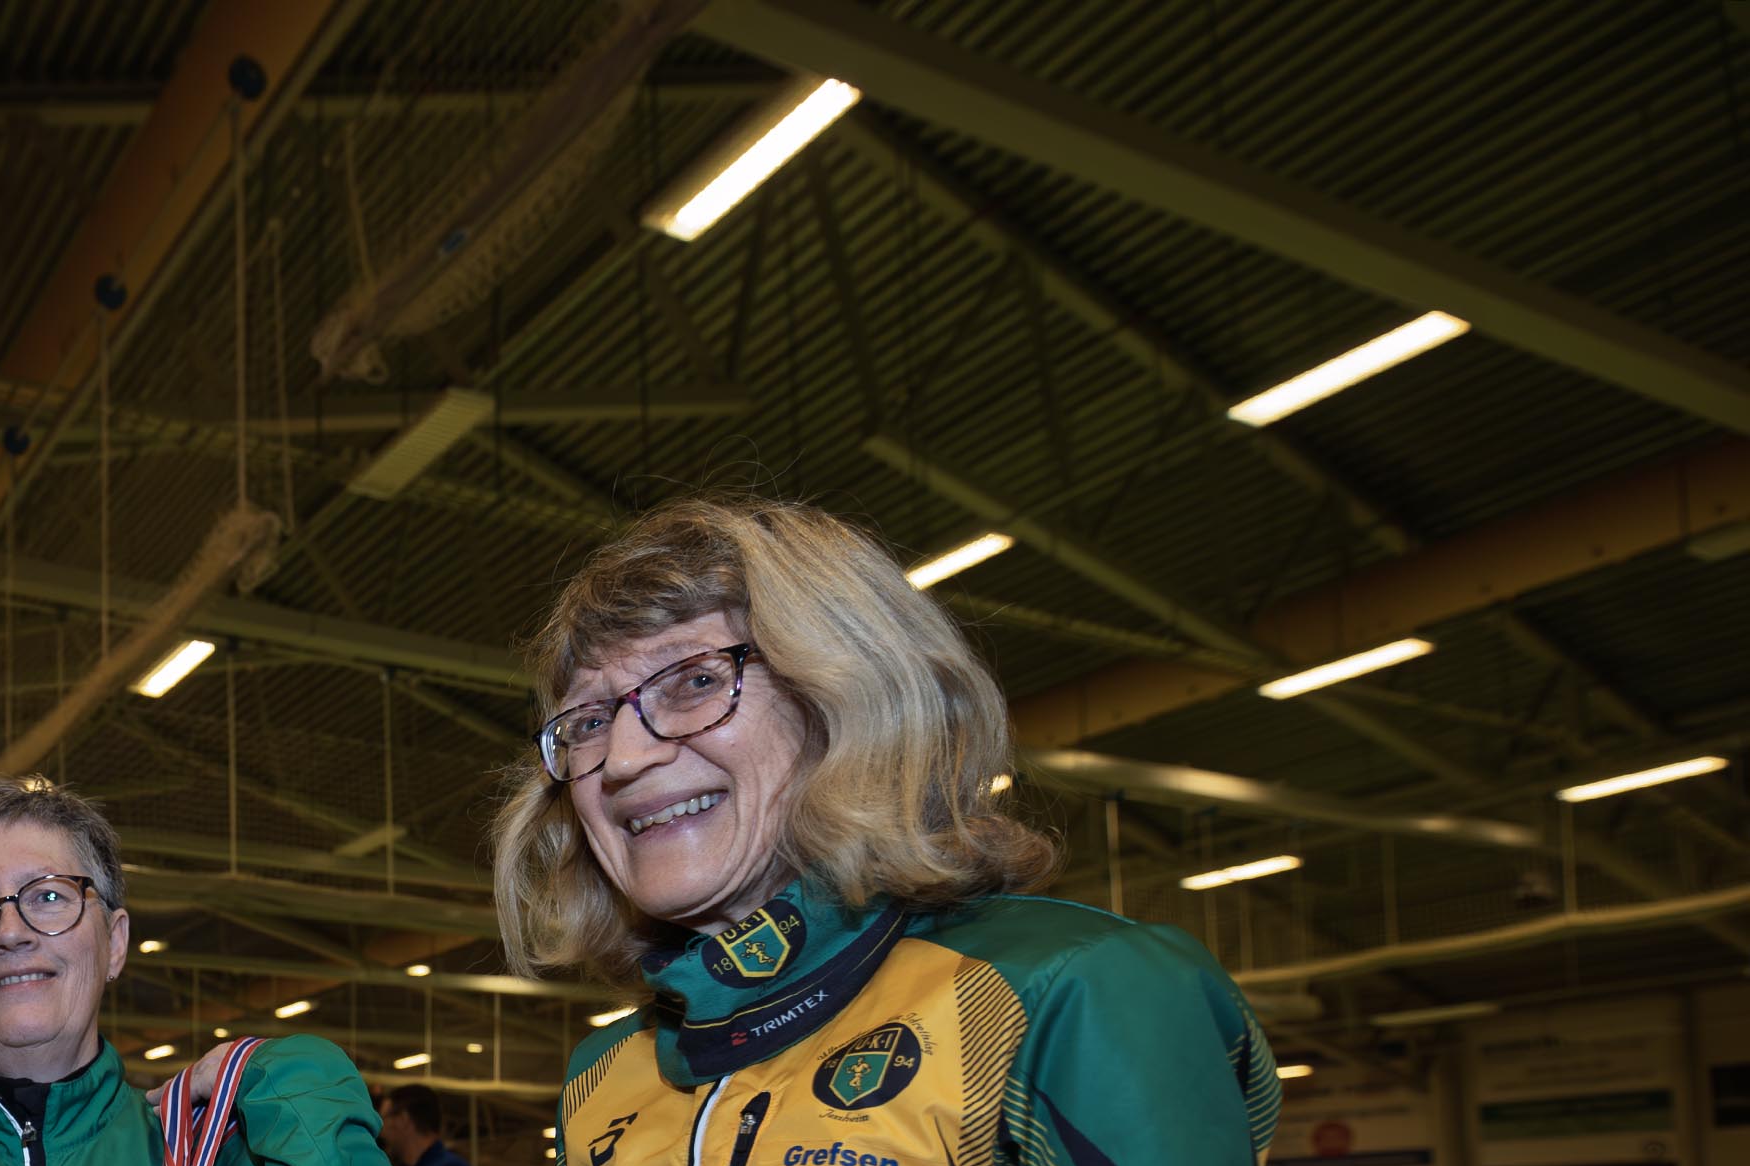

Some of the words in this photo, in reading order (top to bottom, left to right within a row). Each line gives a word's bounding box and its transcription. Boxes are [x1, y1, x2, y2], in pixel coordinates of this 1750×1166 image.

[712, 957, 734, 975] 18
[778, 914, 800, 935] 94
[751, 989, 830, 1037] TRIMTEX
[893, 1055, 916, 1069] 94
